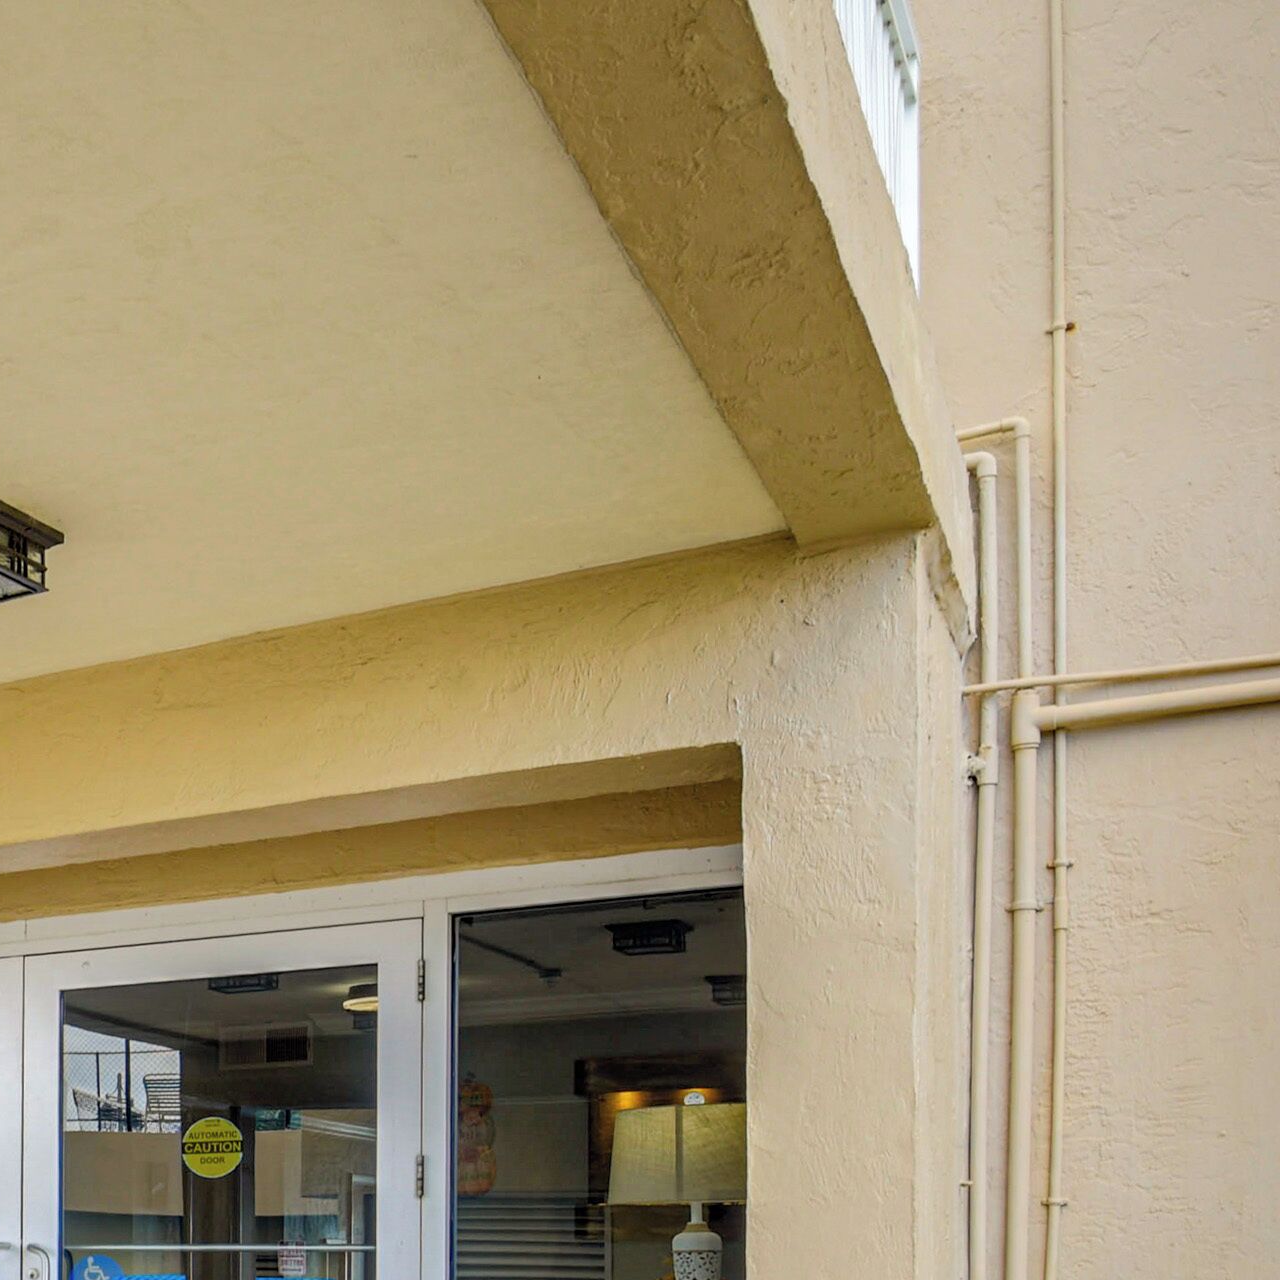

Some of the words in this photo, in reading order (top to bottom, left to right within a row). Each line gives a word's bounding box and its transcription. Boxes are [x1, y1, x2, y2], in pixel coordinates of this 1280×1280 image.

[188, 1130, 238, 1140] AUTOMATIC
[184, 1141, 242, 1154] CAUTION
[200, 1156, 225, 1165] DOOR
